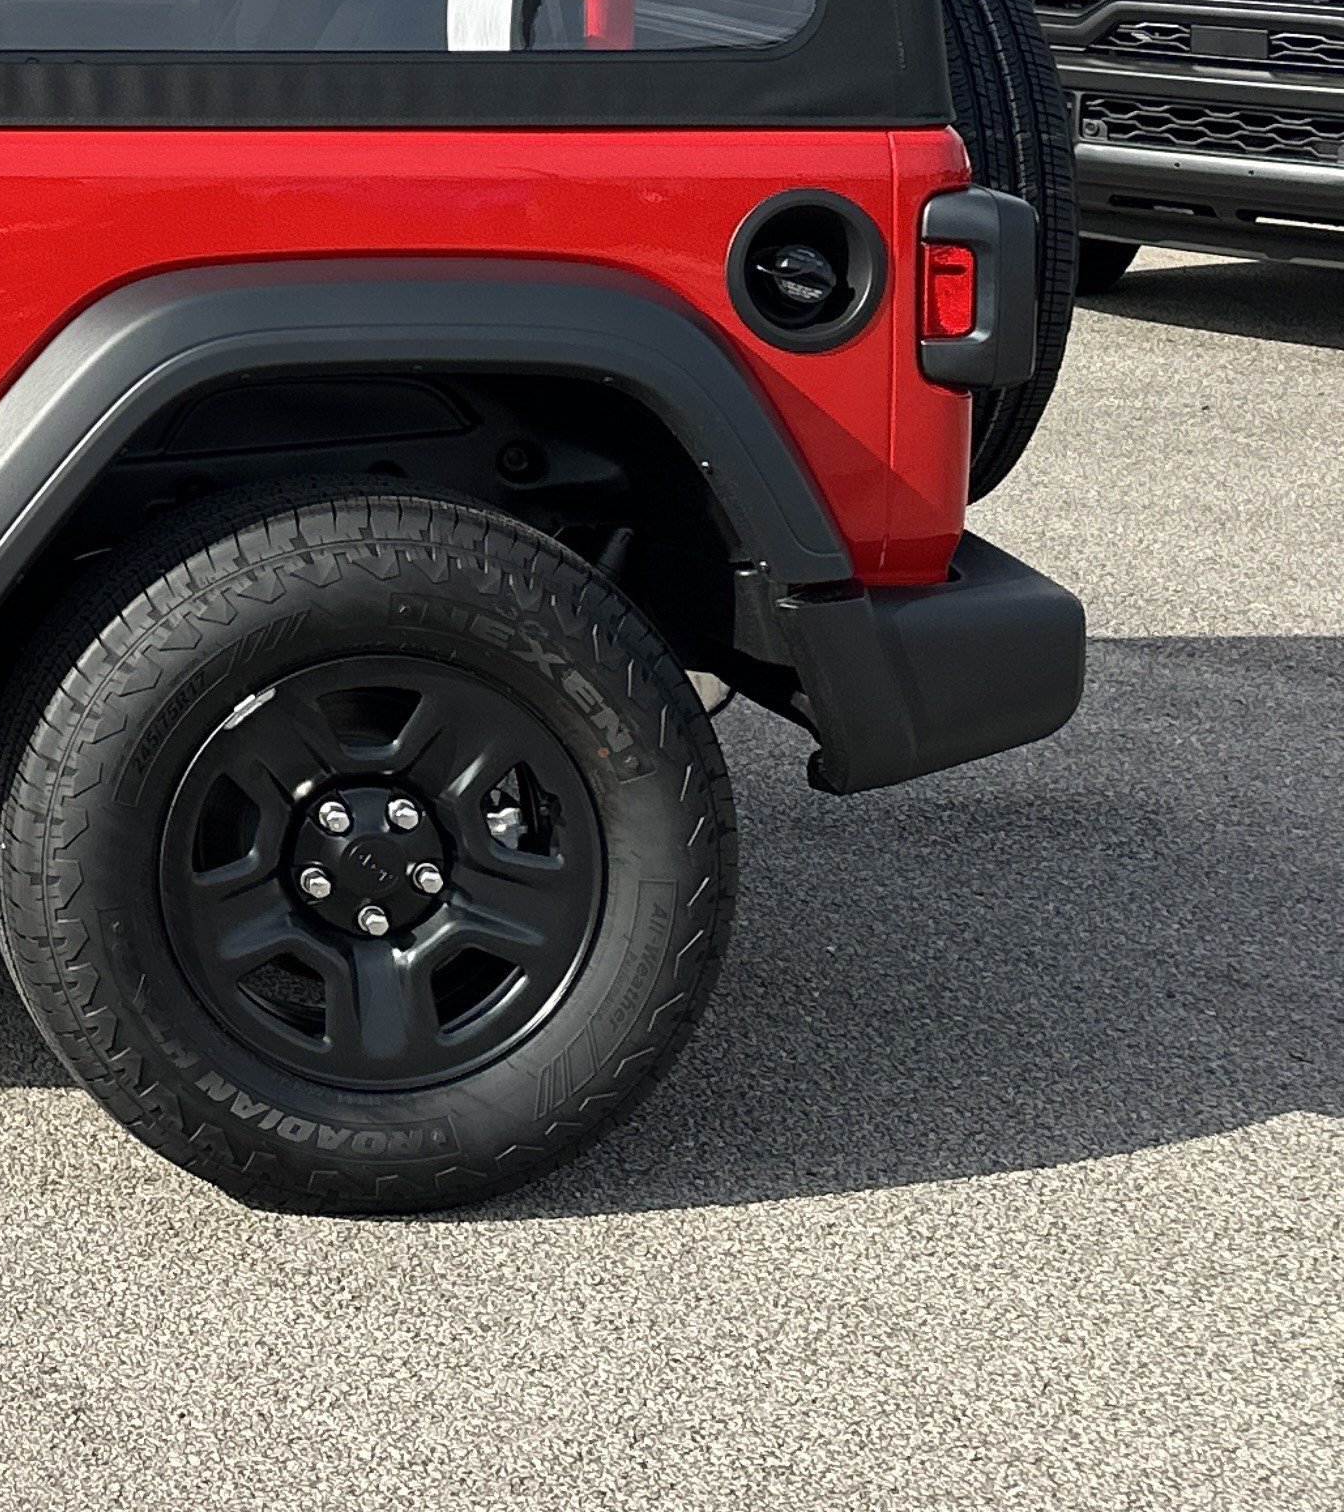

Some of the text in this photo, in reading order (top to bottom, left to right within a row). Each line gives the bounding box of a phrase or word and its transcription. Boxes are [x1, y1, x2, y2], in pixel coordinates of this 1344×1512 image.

[130, 672, 204, 773] 245/75R17
[423, 598, 632, 753] NEXEN
[609, 903, 663, 1034] All-Weather
[194, 1071, 423, 1155] ROADIAN
